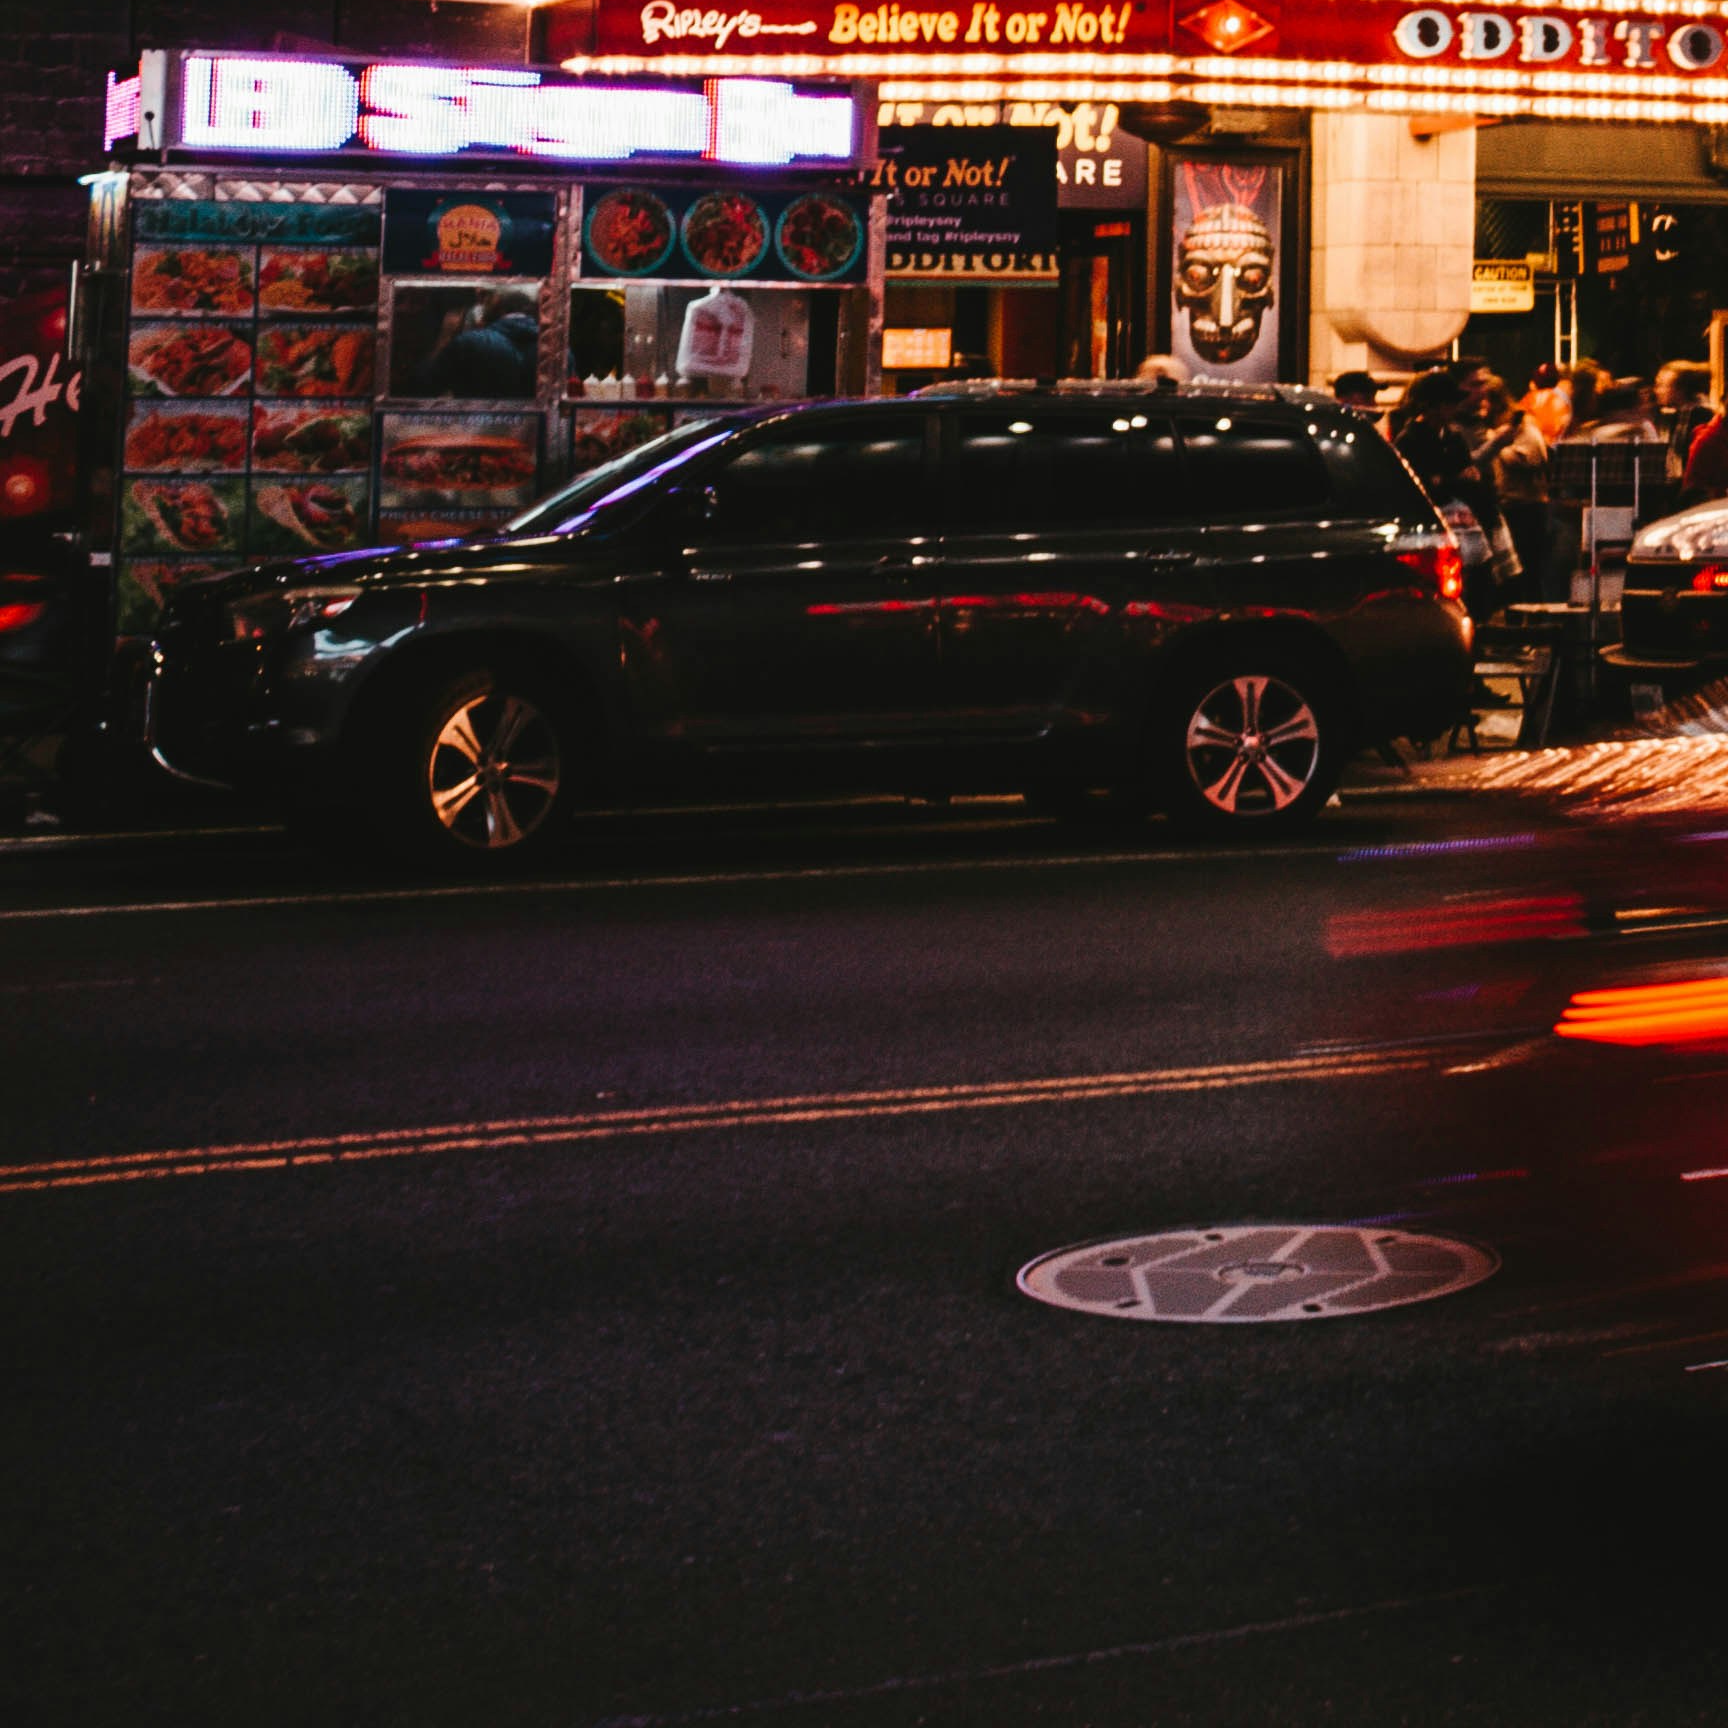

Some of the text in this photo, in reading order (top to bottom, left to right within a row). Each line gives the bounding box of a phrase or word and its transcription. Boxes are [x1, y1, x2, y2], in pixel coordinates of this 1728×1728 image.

[640, 0, 1130, 54] Ripley's Believe It or Not!
[903, 165, 938, 187] or
[941, 155, 1011, 188] Not!
[918, 192, 1010, 208] SQUARE
[916, 231, 940, 245] tag
[1473, 265, 1529, 281] CAUTION
